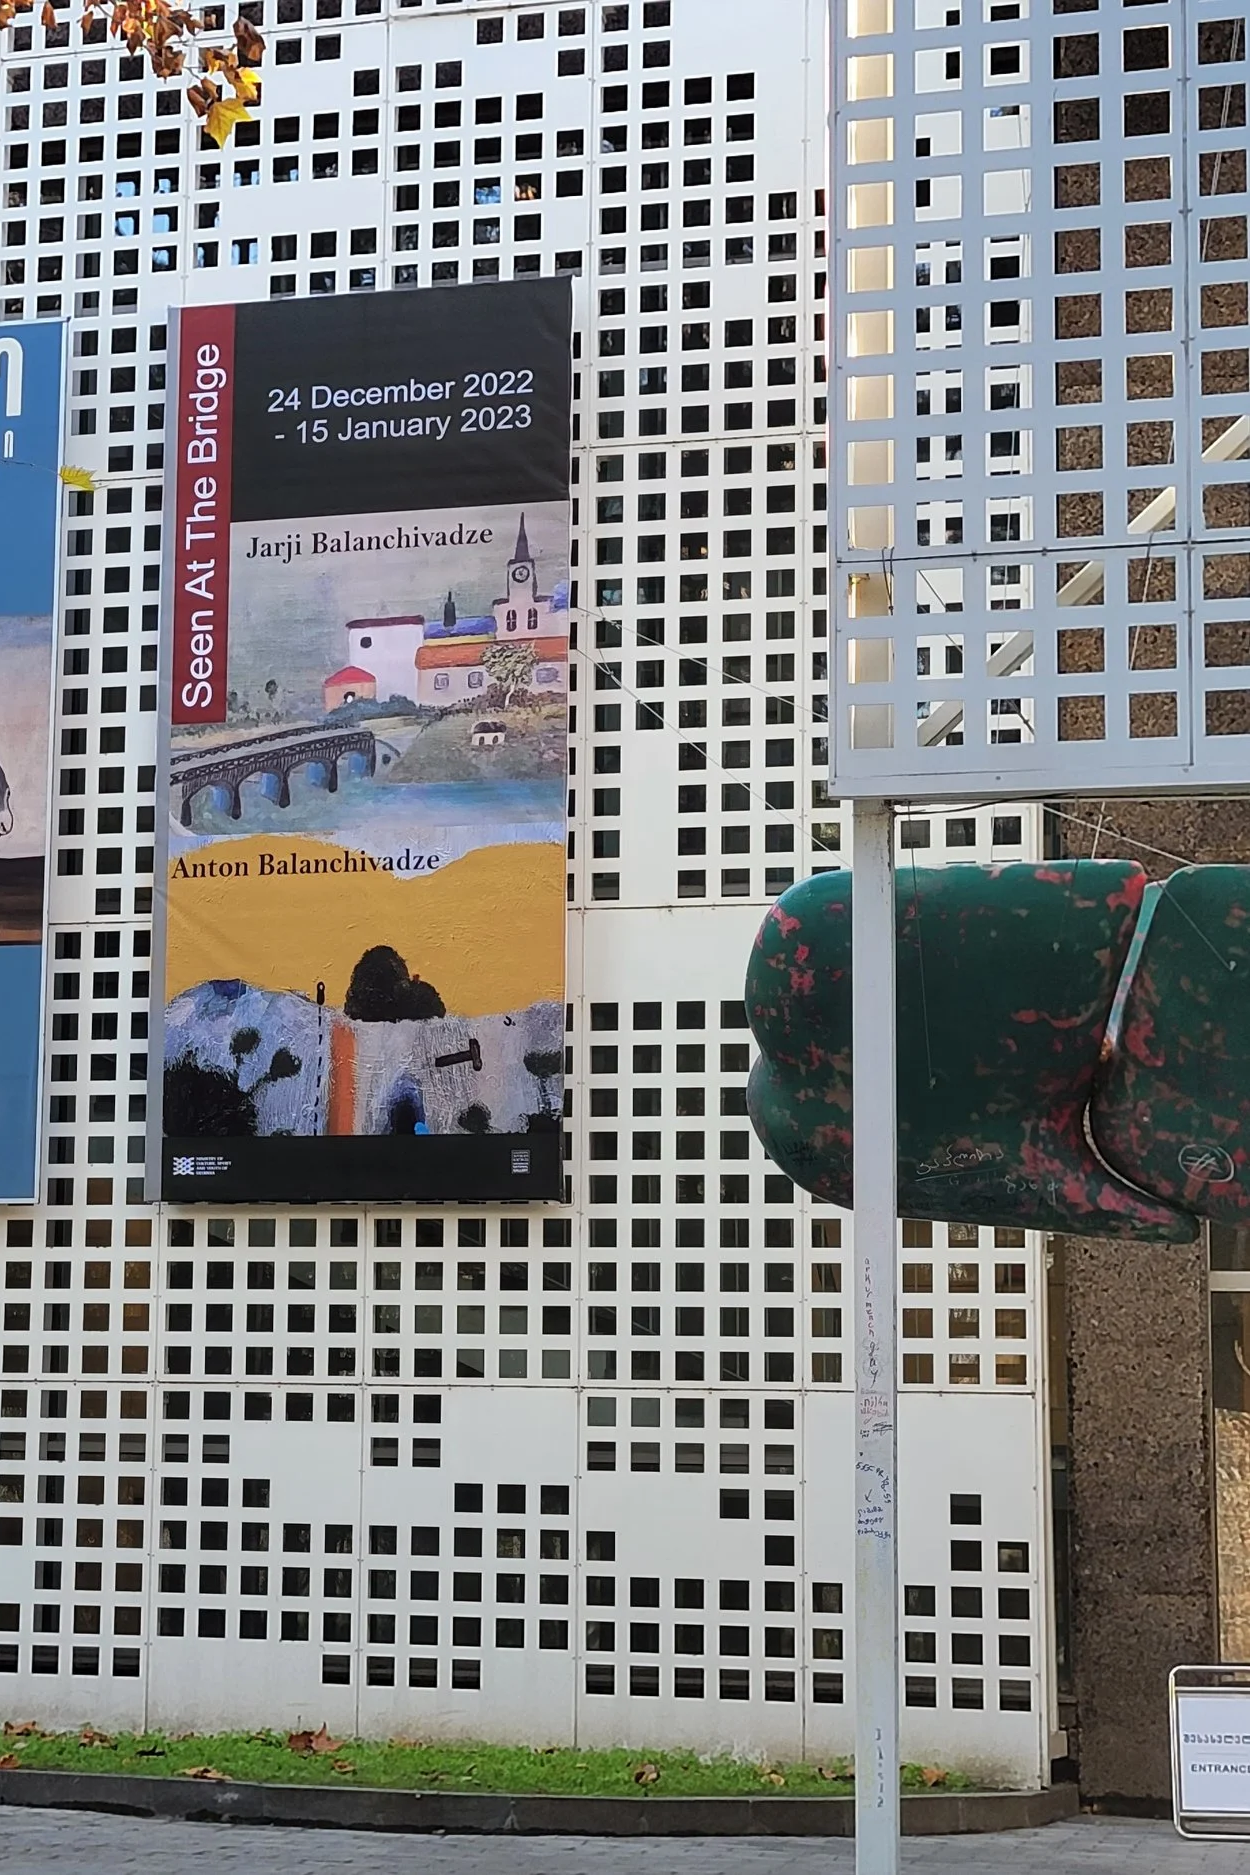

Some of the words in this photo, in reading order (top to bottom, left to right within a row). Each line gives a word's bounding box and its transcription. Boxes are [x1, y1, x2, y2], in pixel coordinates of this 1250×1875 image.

[187, 344, 227, 464] Bridge
[267, 386, 301, 413] 24
[311, 378, 456, 410] December
[463, 369, 534, 398] 2022
[296, 419, 329, 444] 15
[338, 414, 452, 441] January
[460, 404, 533, 433] 2023
[185, 476, 217, 550] The
[246, 534, 302, 564] Jarji
[311, 523, 494, 555] Balanchivadze
[184, 559, 215, 600] At
[182, 609, 214, 708] Seen
[171, 857, 249, 880] Anton
[258, 848, 441, 876] Balanchivadze
